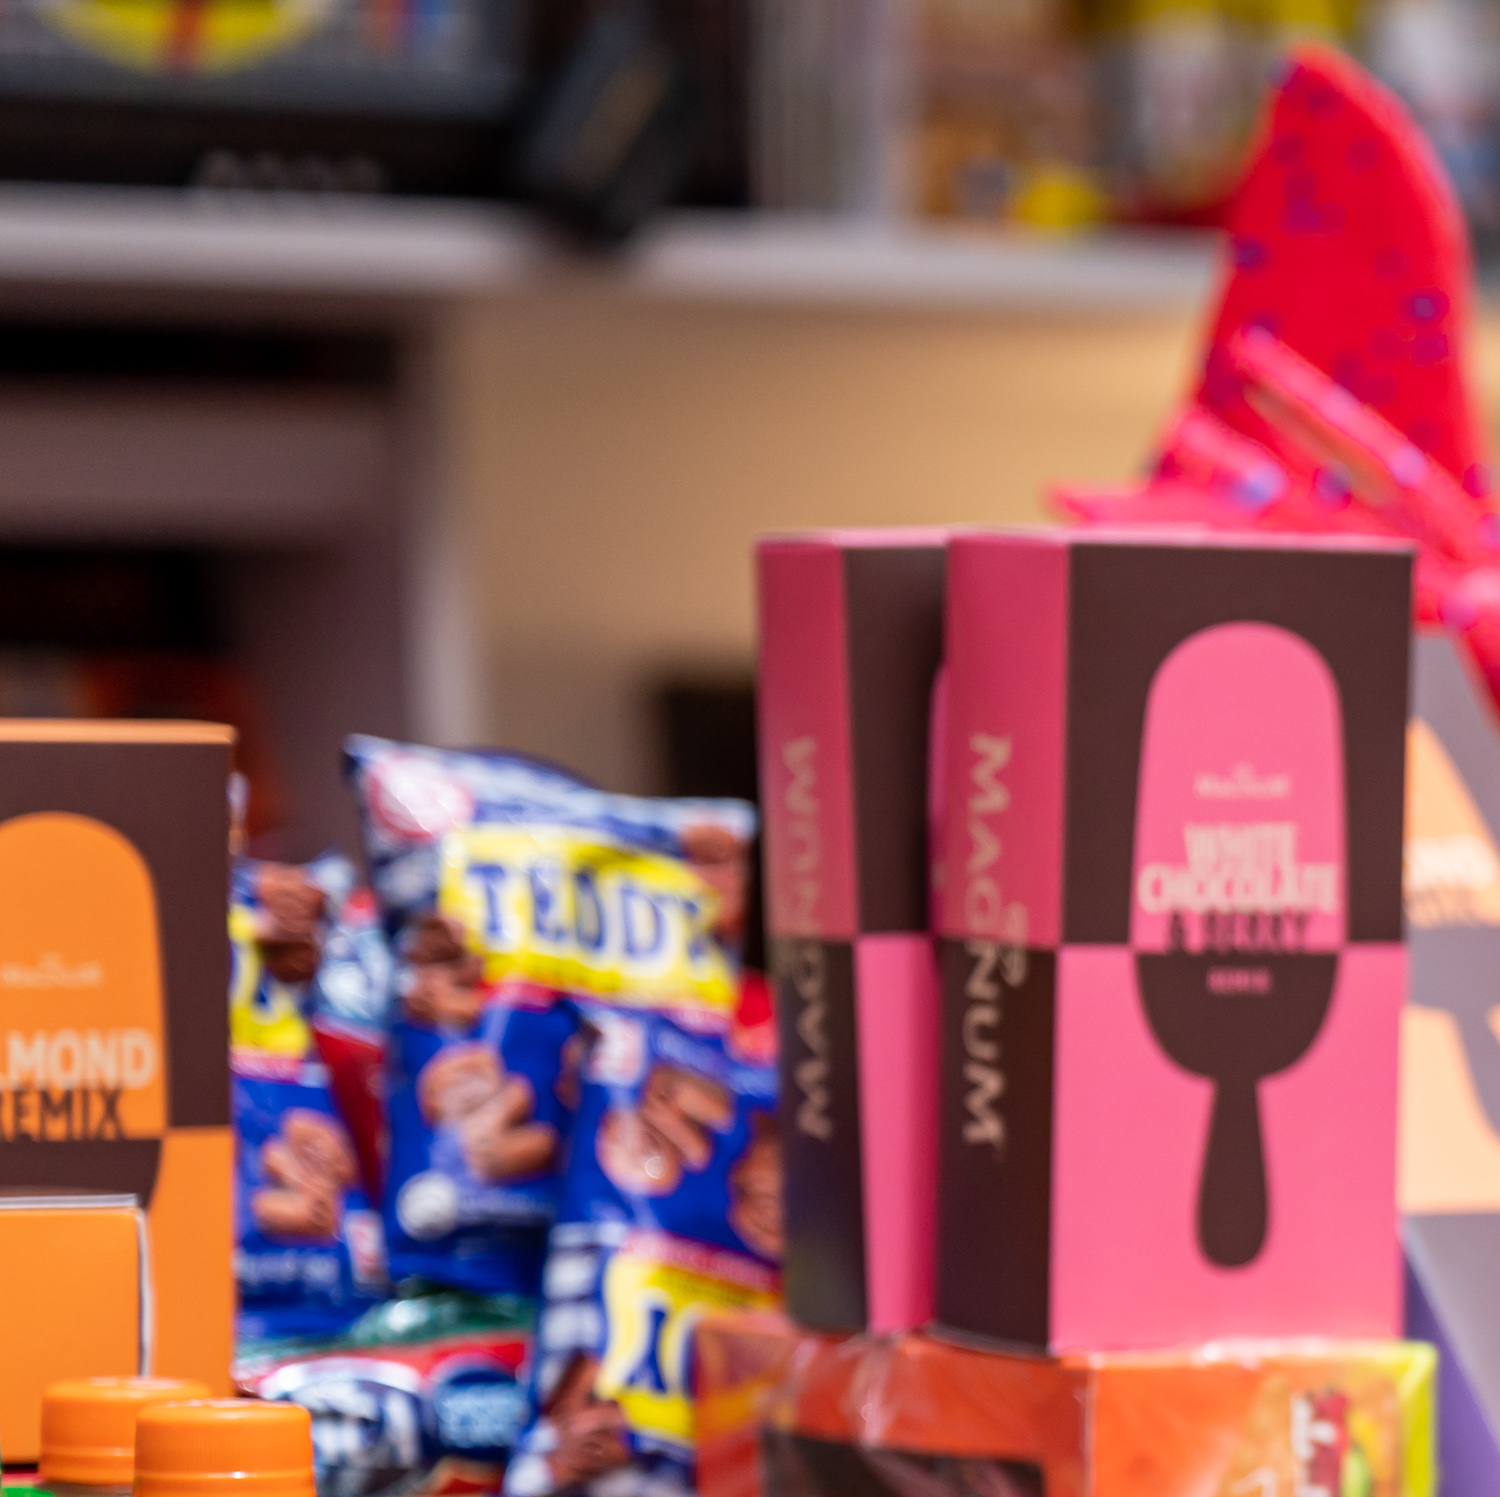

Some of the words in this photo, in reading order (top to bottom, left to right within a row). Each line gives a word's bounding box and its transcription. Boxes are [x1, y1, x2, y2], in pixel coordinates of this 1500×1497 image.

[780, 736, 834, 1141] MAGNUM
[961, 732, 1013, 1145] MAGNUM
[0, 1028, 156, 1091] MOND
[0, 1086, 126, 1142] EMIX
